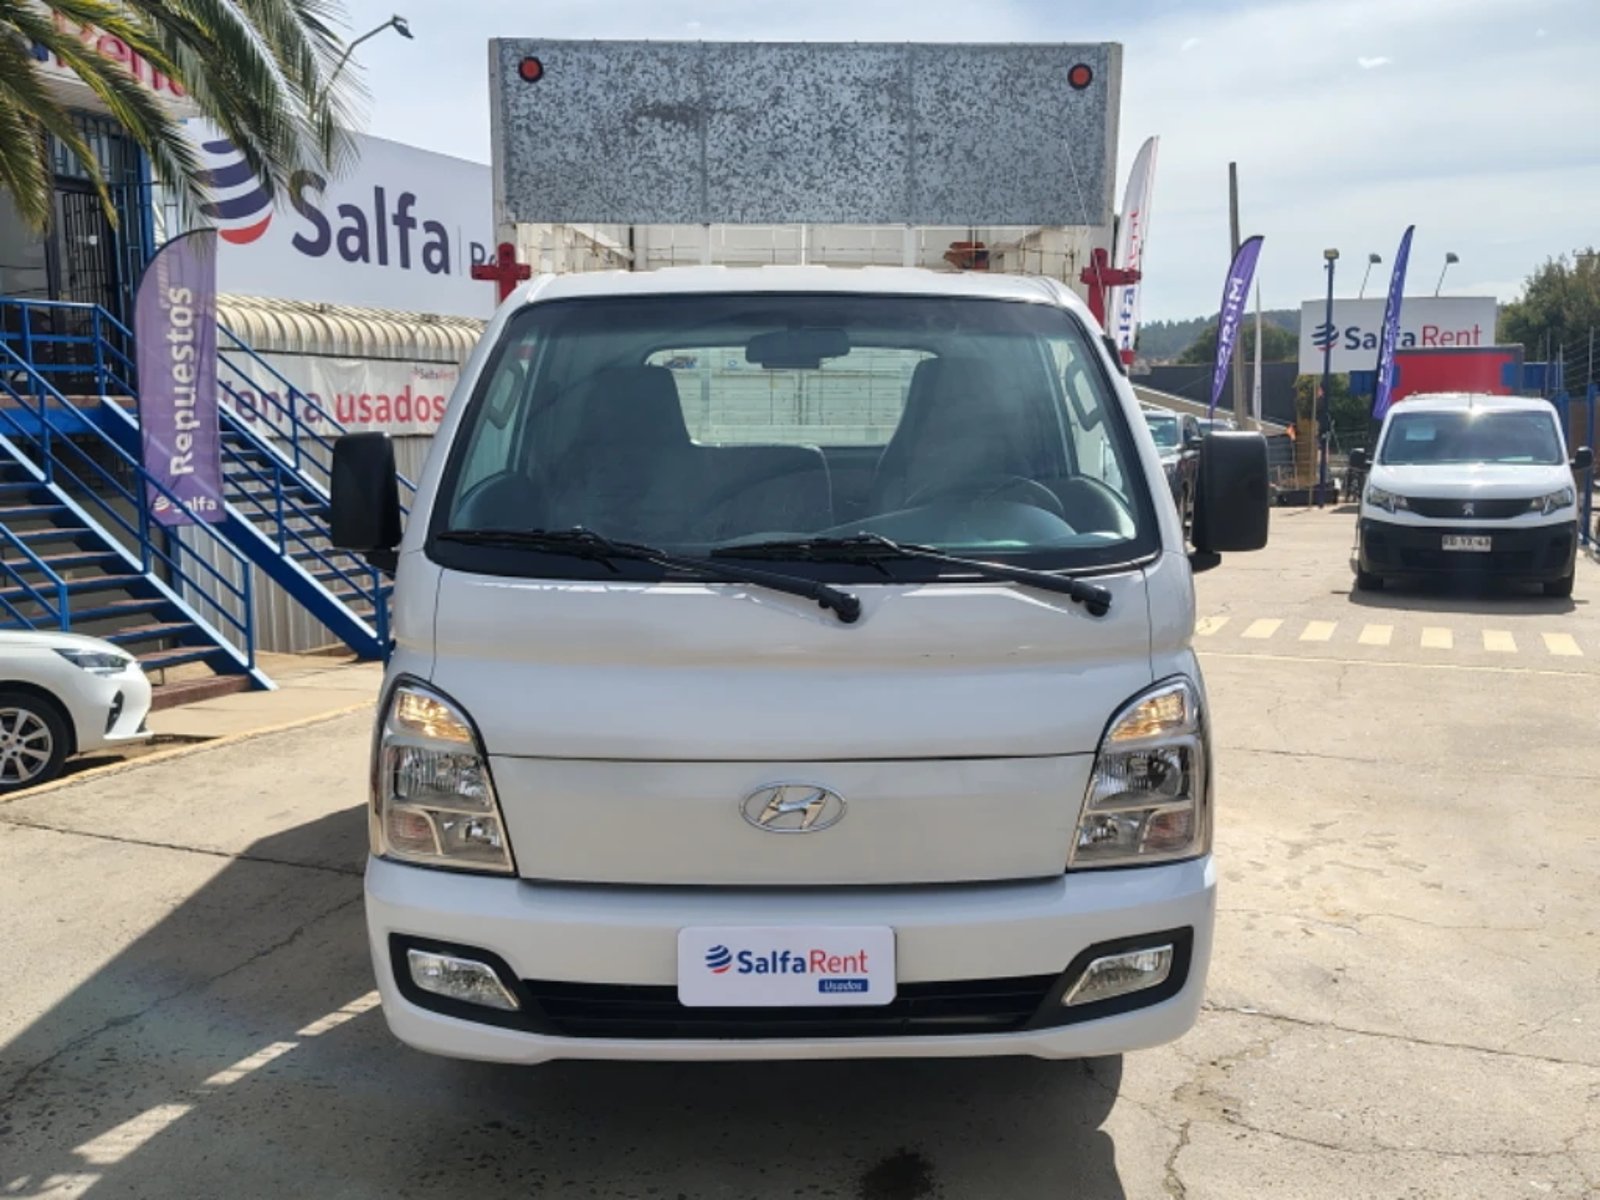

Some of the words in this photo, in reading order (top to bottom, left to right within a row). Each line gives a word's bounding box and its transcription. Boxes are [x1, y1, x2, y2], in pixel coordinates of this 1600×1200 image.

[290, 169, 451, 275] Salfa
[169, 286, 200, 477] Repuestos
[221, 380, 323, 424] ena
[335, 384, 446, 425] usados
